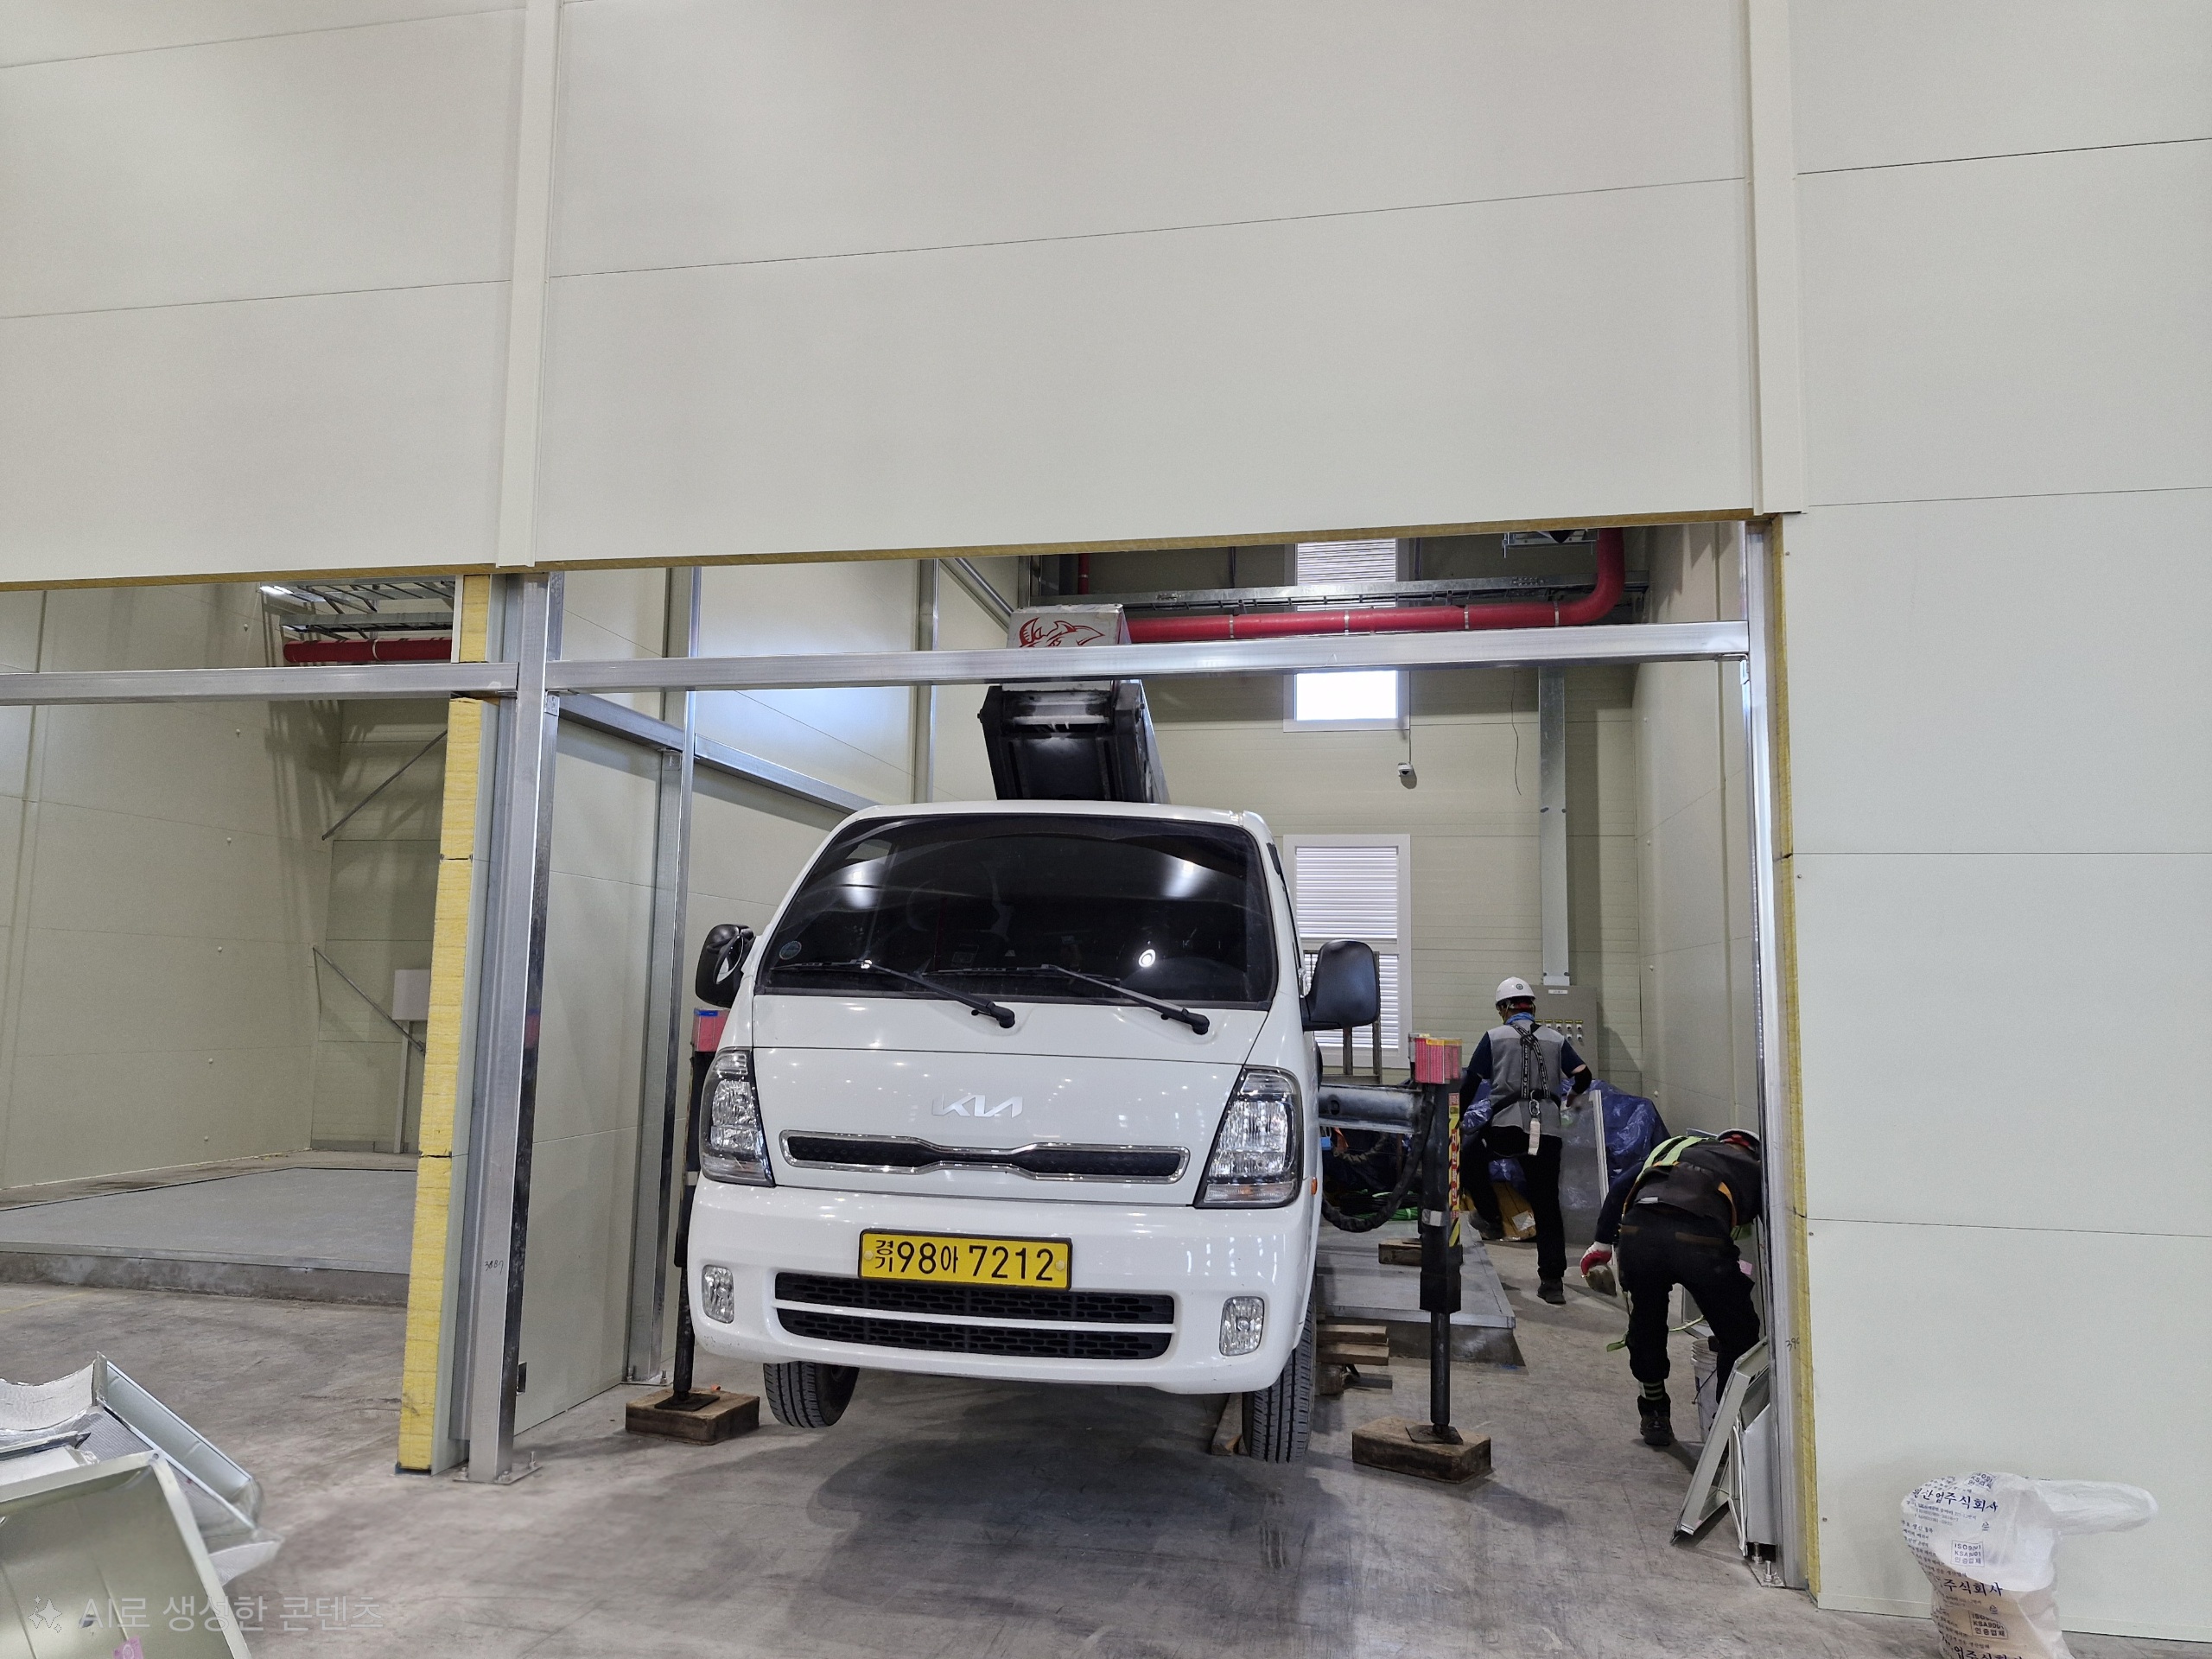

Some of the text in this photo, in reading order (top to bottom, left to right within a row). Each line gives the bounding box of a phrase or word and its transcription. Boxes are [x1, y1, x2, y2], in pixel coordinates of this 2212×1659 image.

[932, 1093, 1023, 1118] KIA
[969, 1245, 1053, 1281] 7212
[1943, 1579, 2003, 1597] 주식회사
